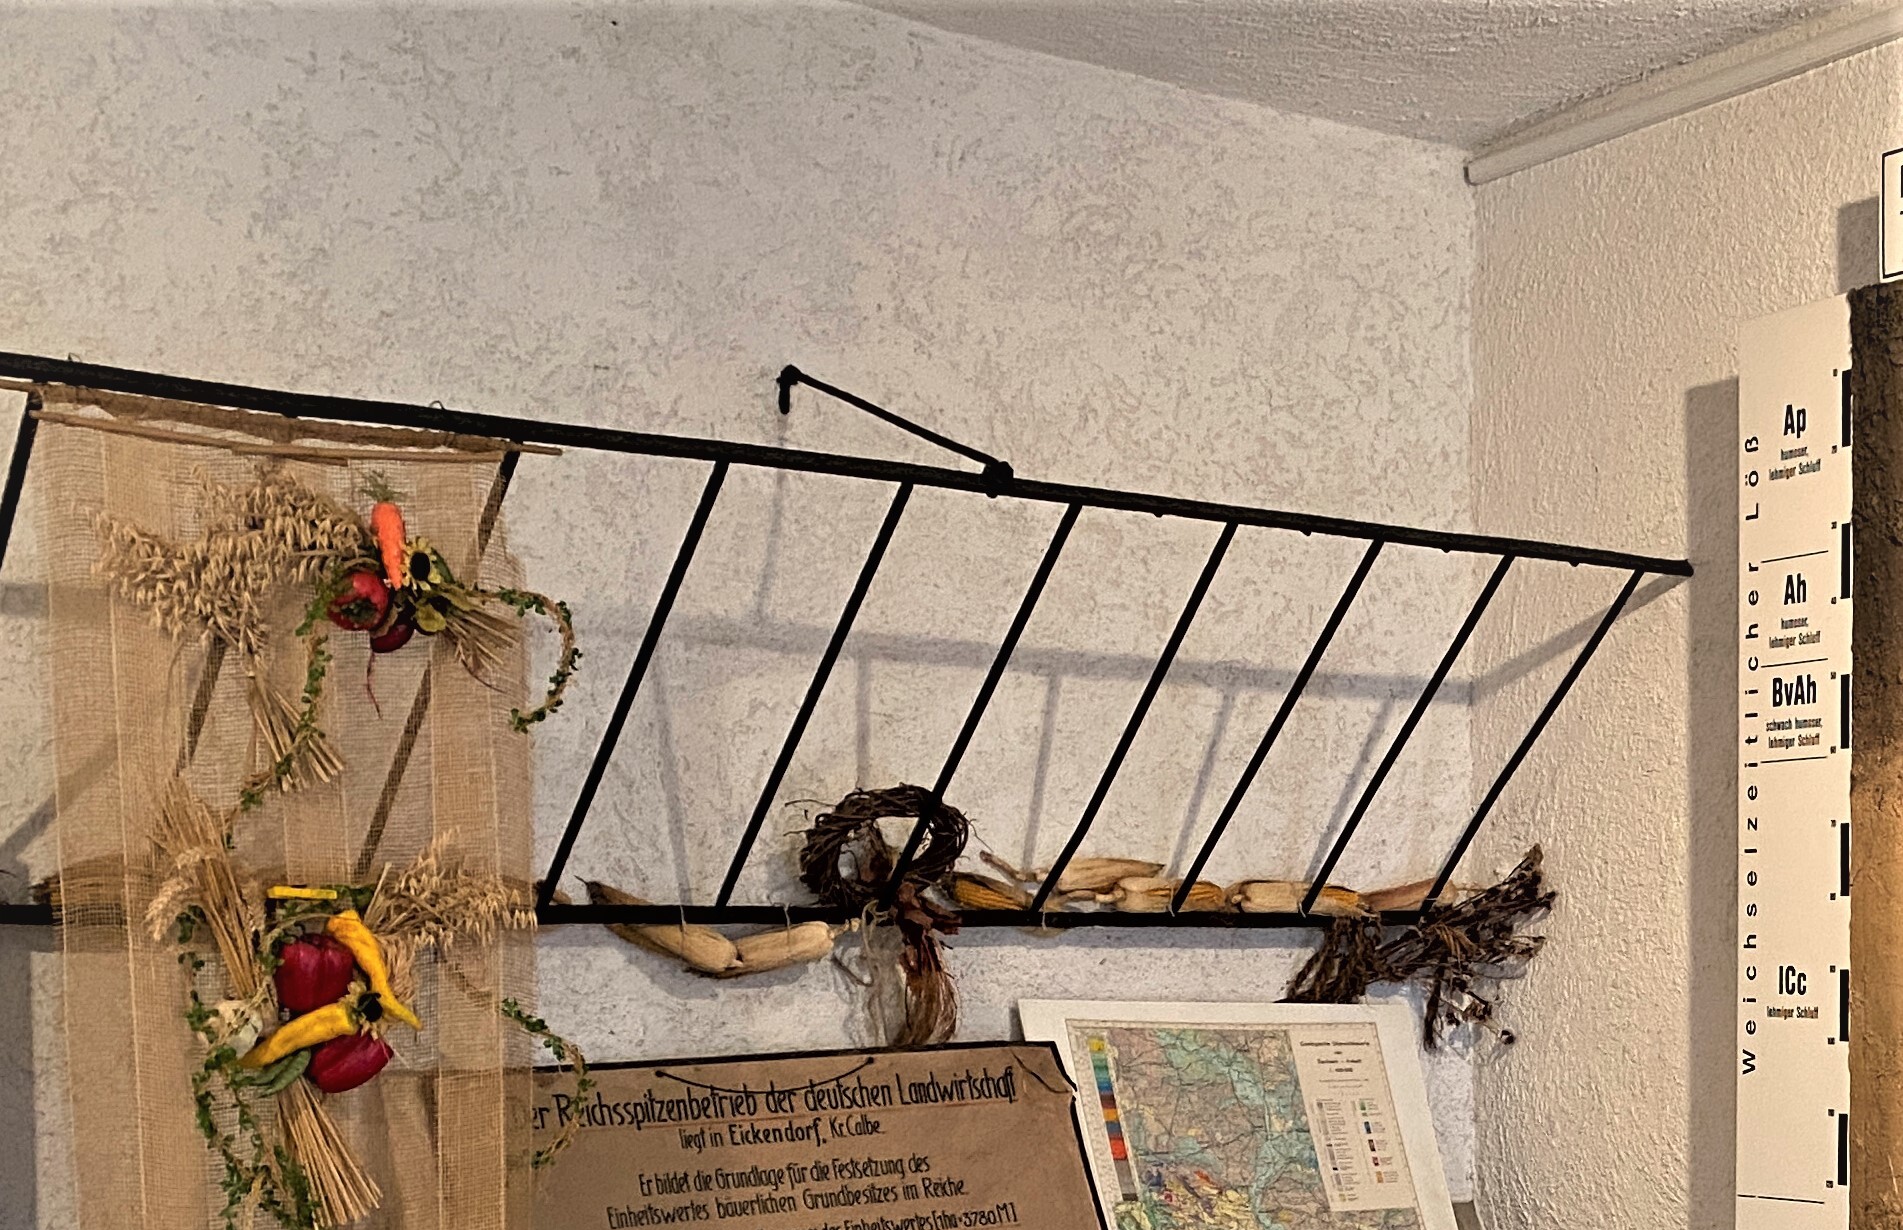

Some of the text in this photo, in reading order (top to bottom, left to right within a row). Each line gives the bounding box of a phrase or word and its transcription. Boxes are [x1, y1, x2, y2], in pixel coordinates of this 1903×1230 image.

[1783, 404, 1806, 439] Ap
[1783, 573, 1806, 605] Ah
[1772, 674, 1816, 707] BvAh
[1778, 965, 1807, 995] ICc
[766, 1080, 796, 1113] der
[804, 1076, 893, 1110] deutschen
[896, 1066, 1016, 1105] Landwirtschaft
[679, 1127, 705, 1154] liegt
[709, 1126, 723, 1147] in
[638, 1153, 931, 1197] Er bildet die Grundlage für die Festsetzung des
[606, 1201, 710, 1230] Einheitswertes
[715, 1192, 798, 1220] bäuerlichen
[802, 1182, 898, 1211] Grundbesitzes
[903, 1183, 919, 1201] im
